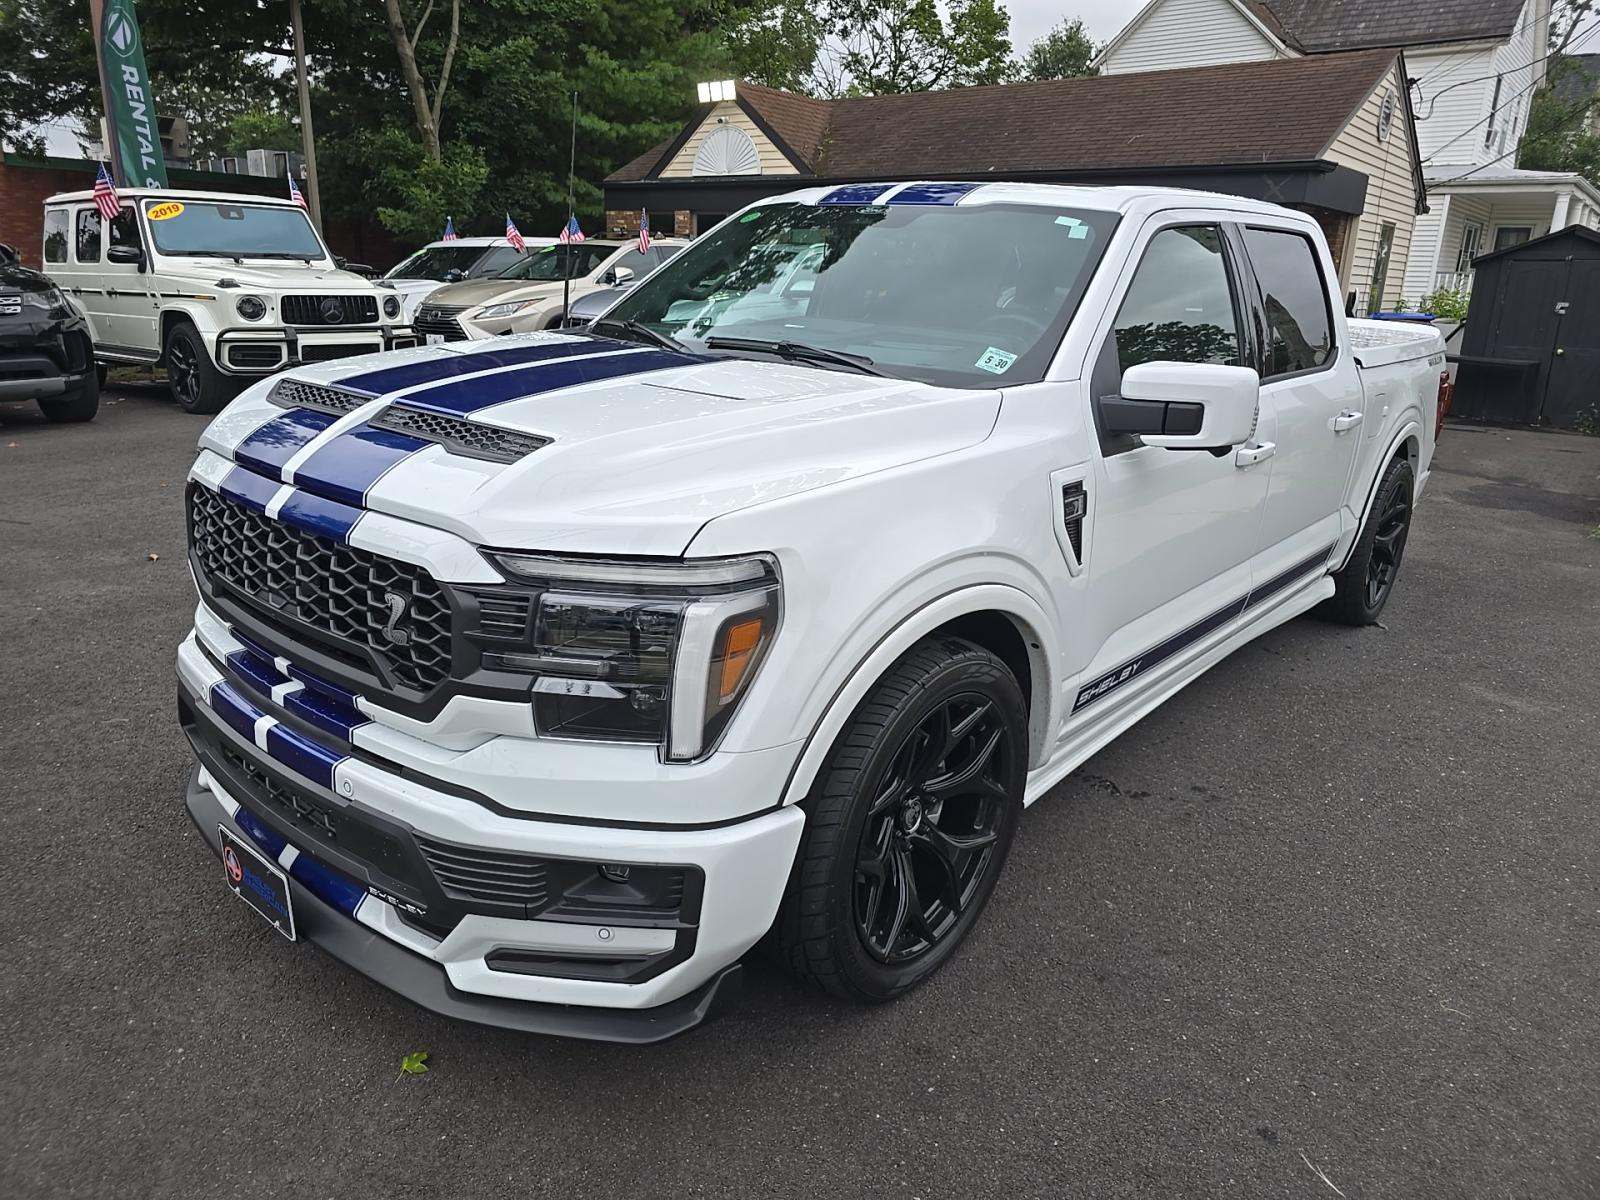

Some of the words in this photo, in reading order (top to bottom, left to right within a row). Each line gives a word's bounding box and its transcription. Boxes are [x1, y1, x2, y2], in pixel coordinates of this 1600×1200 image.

[121, 64, 156, 170] RENTAL
[152, 204, 179, 218] 2019
[985, 356, 994, 364] 5
[995, 359, 1008, 368] 30
[1077, 660, 1142, 706] SHELBY
